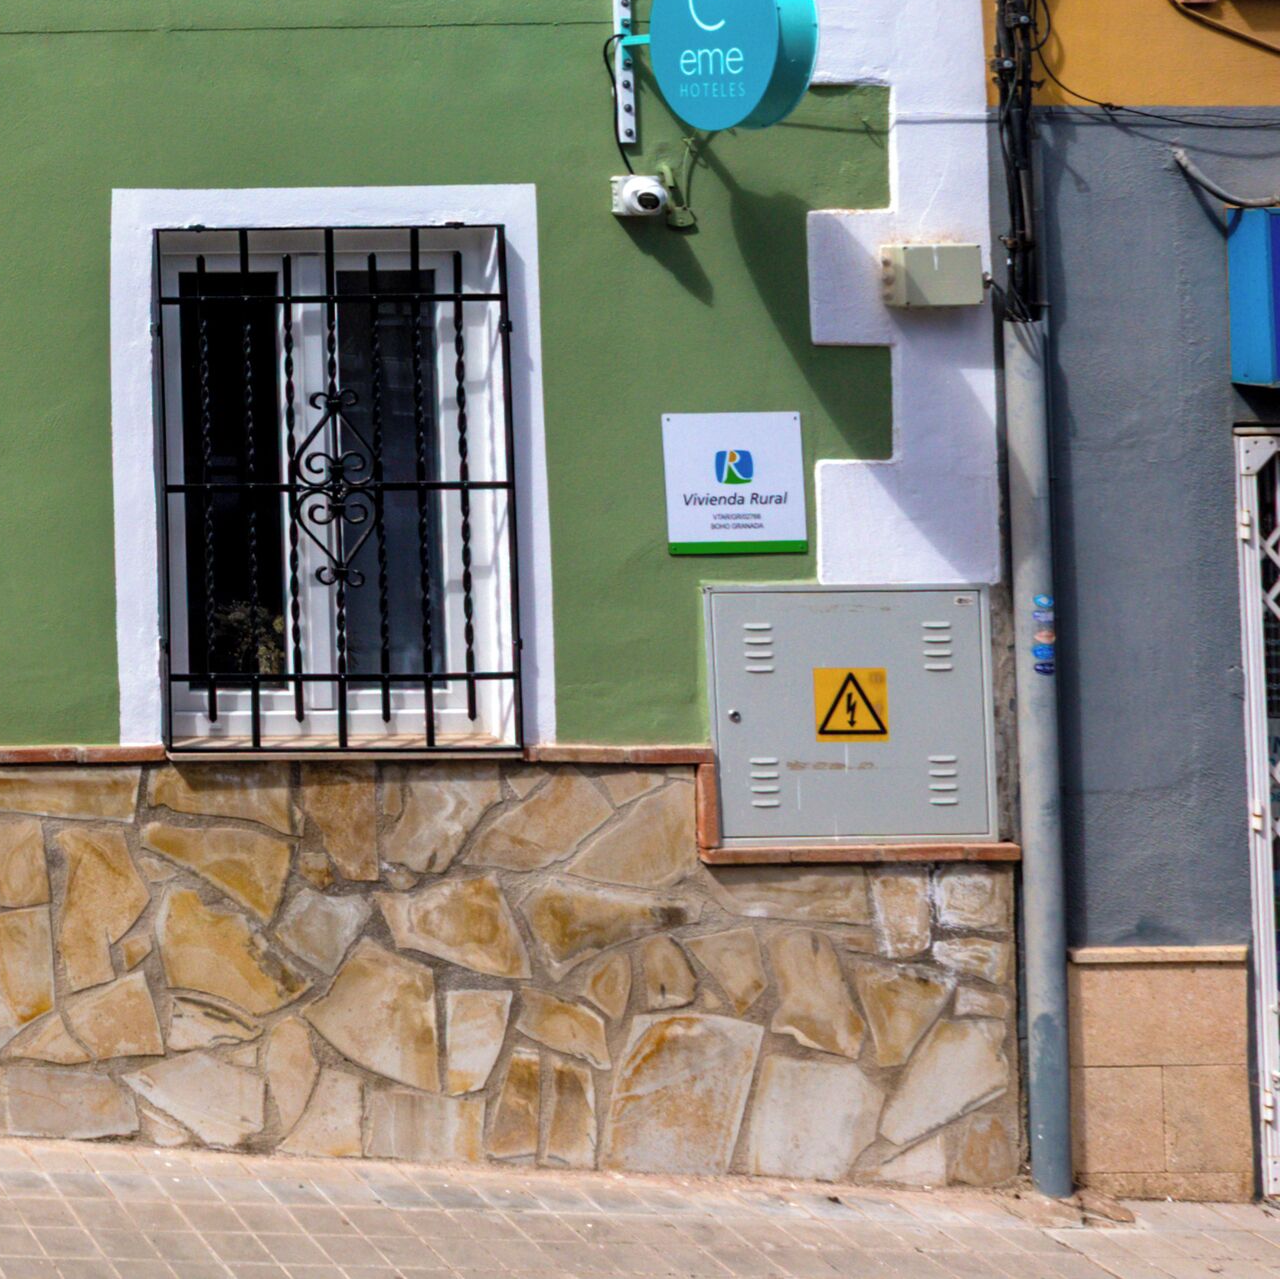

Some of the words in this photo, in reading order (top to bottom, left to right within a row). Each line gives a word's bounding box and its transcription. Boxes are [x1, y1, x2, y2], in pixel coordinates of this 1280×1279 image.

[680, 47, 744, 76] eme
[679, 82, 746, 98] HOTELES
[683, 493, 745, 506] Vivienda
[750, 492, 788, 505] Rural
